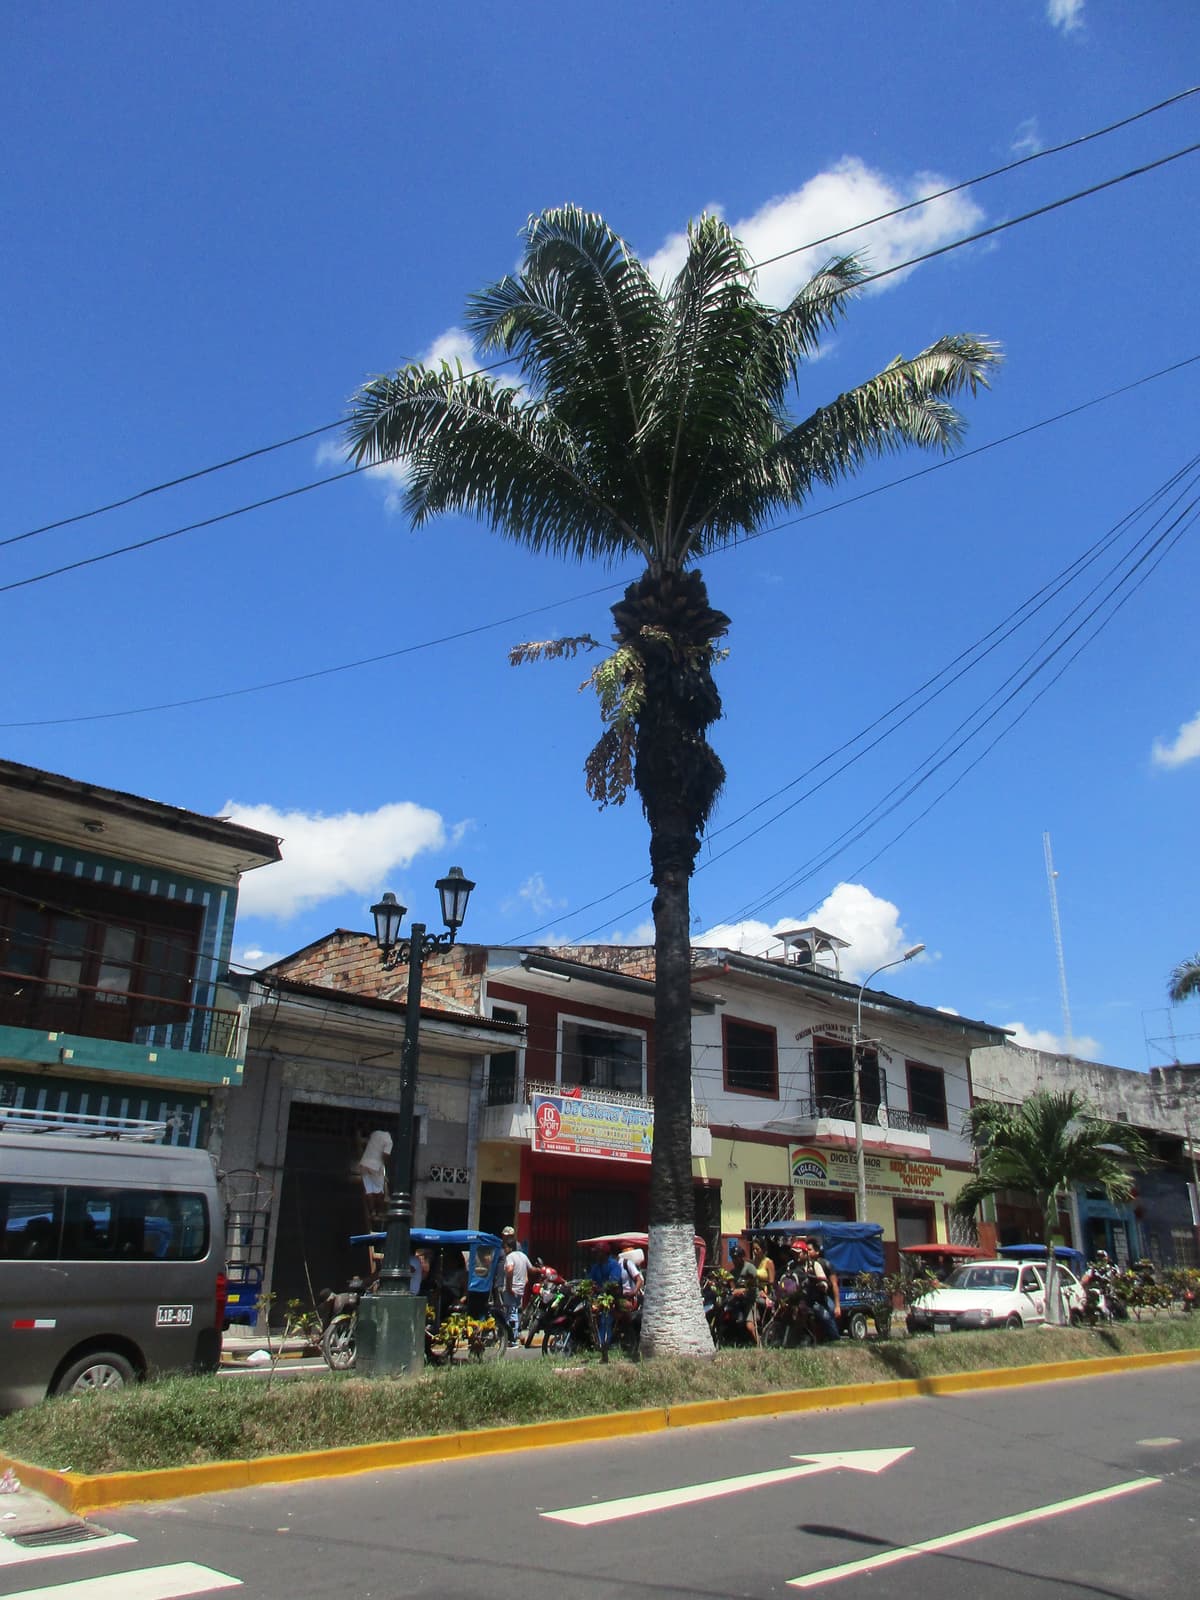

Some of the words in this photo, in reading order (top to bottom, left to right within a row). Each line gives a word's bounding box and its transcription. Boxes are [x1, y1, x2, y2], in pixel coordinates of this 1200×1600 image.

[830, 1152, 848, 1164] DIOS
[863, 1156, 880, 1168] MOR
[796, 1163, 824, 1178] IGLESIA
[908, 1163, 942, 1177] NACIONAL
[793, 1178, 826, 1187] PENTECOSTAL
